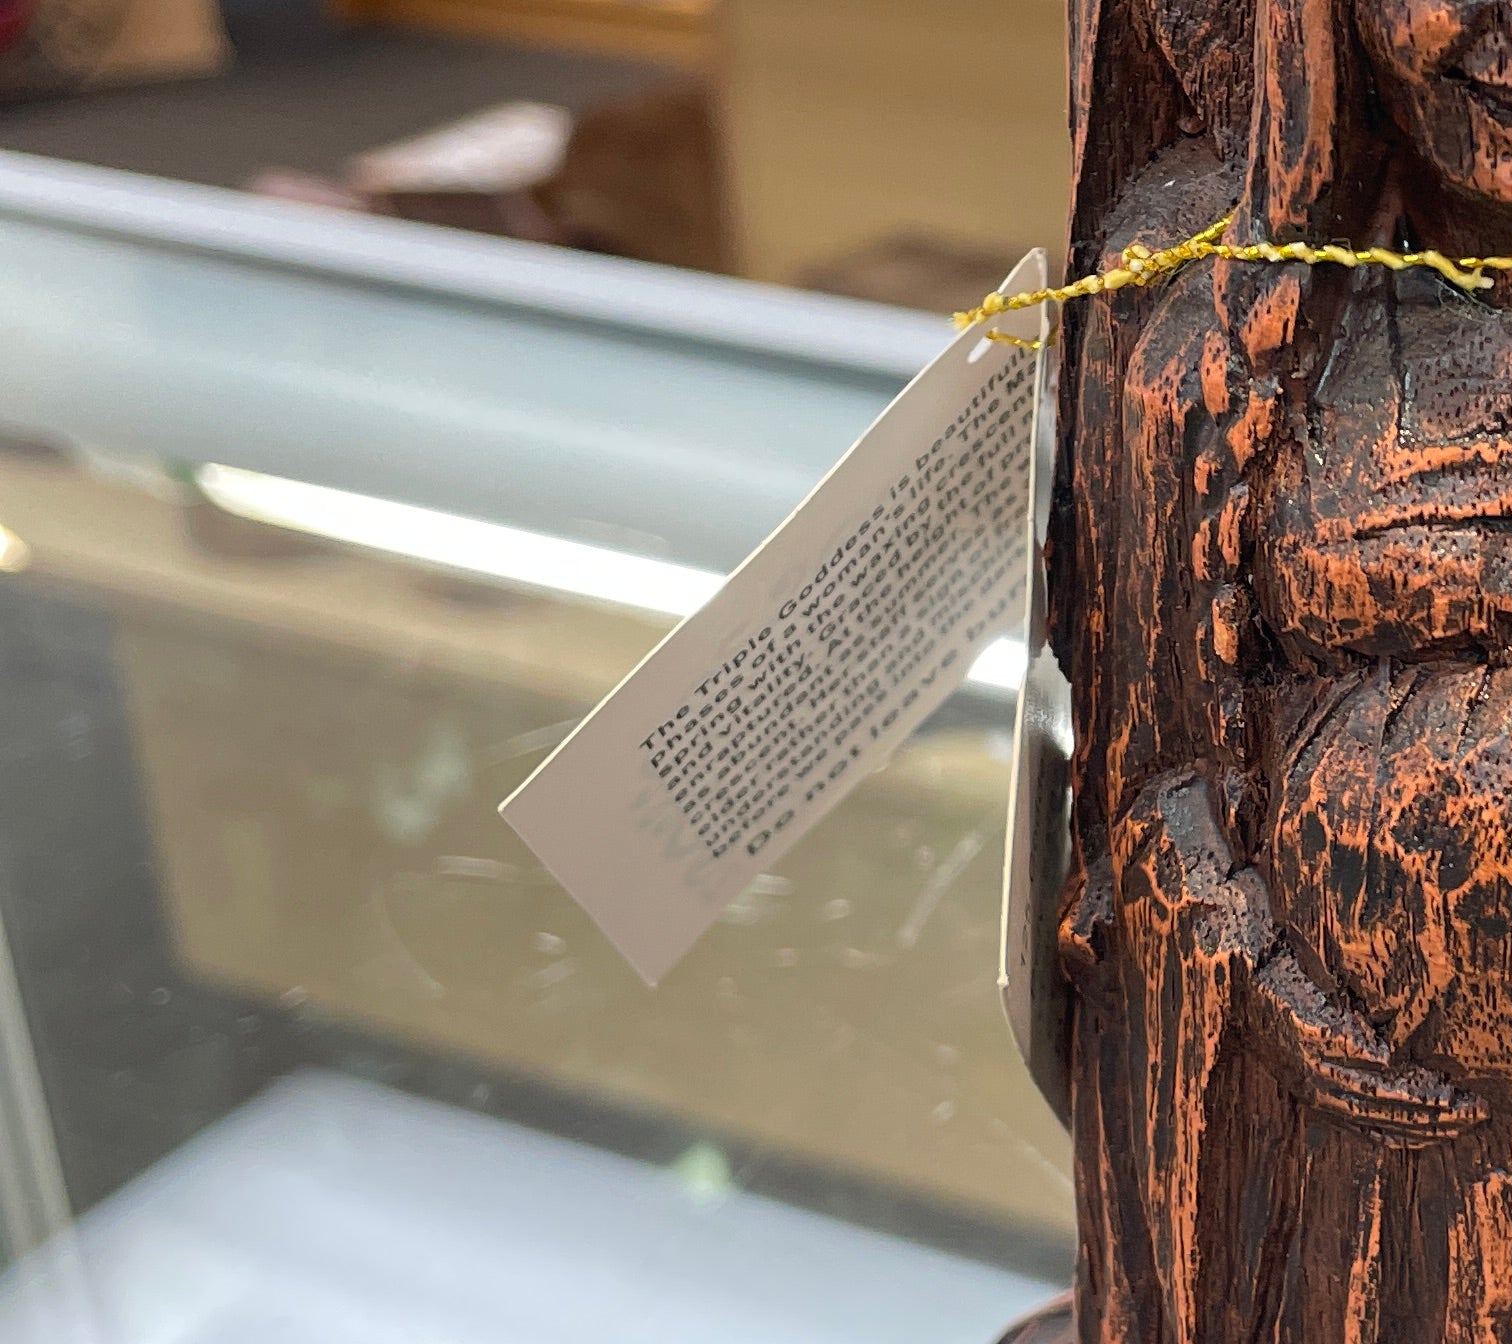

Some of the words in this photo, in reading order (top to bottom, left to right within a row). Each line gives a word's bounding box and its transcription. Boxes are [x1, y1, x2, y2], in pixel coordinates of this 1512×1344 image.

[638, 703, 690, 750] The
[692, 625, 772, 696] Triple
[777, 503, 885, 621] Goddess
[888, 473, 911, 501] is
[914, 344, 1026, 472] beautifull
[649, 673, 744, 770] phases
[750, 637, 775, 670] of
[782, 622, 797, 640] a
[800, 502, 906, 618] woman's
[956, 396, 1001, 442] The
[657, 694, 743, 779] spring
[746, 638, 802, 691] with
[805, 592, 846, 635] the
[849, 494, 931, 588] waxing
[666, 739, 714, 791] and
[716, 650, 813, 738] vitality.
[817, 547, 902, 643] Graced
[904, 513, 931, 548] by
[935, 470, 974, 512] the
